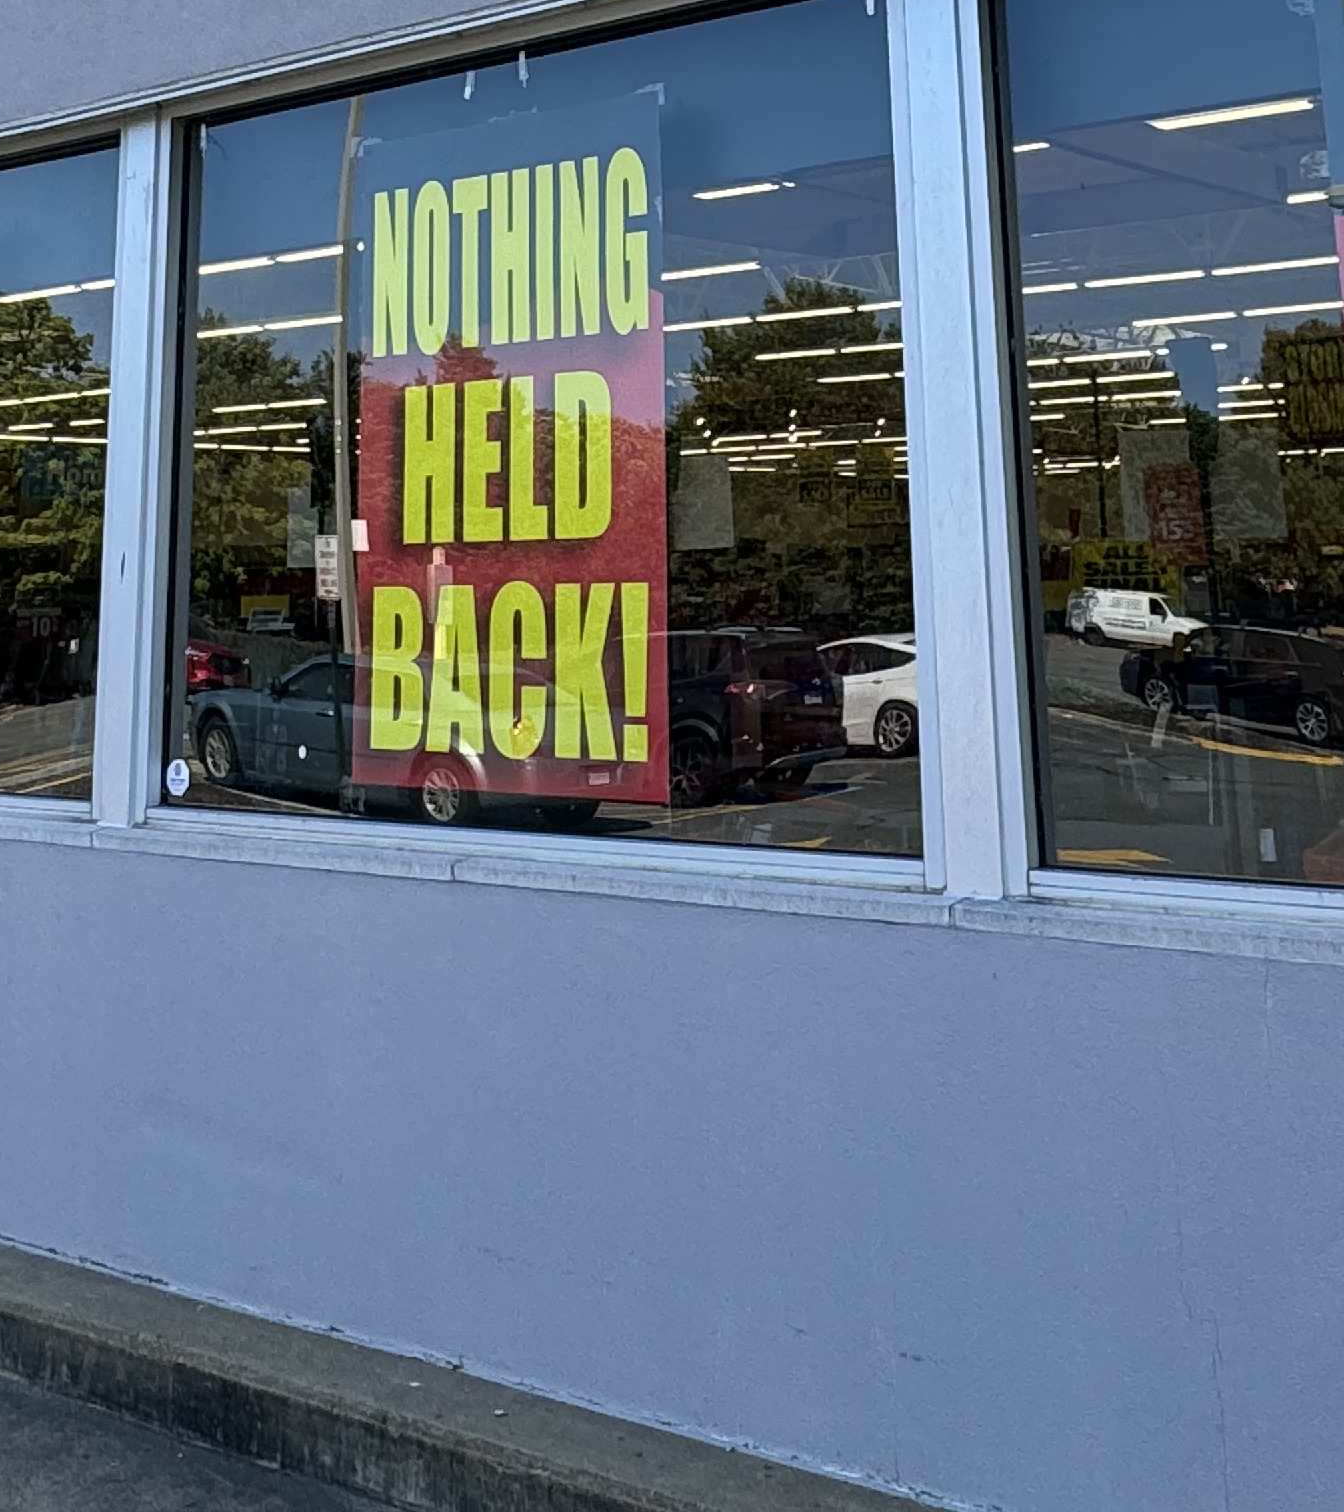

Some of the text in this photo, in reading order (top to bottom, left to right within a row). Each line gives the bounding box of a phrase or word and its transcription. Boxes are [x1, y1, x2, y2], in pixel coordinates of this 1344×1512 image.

[371, 146, 650, 357] NOTHING
[402, 370, 614, 545] HELD
[369, 580, 650, 764] BACK!
